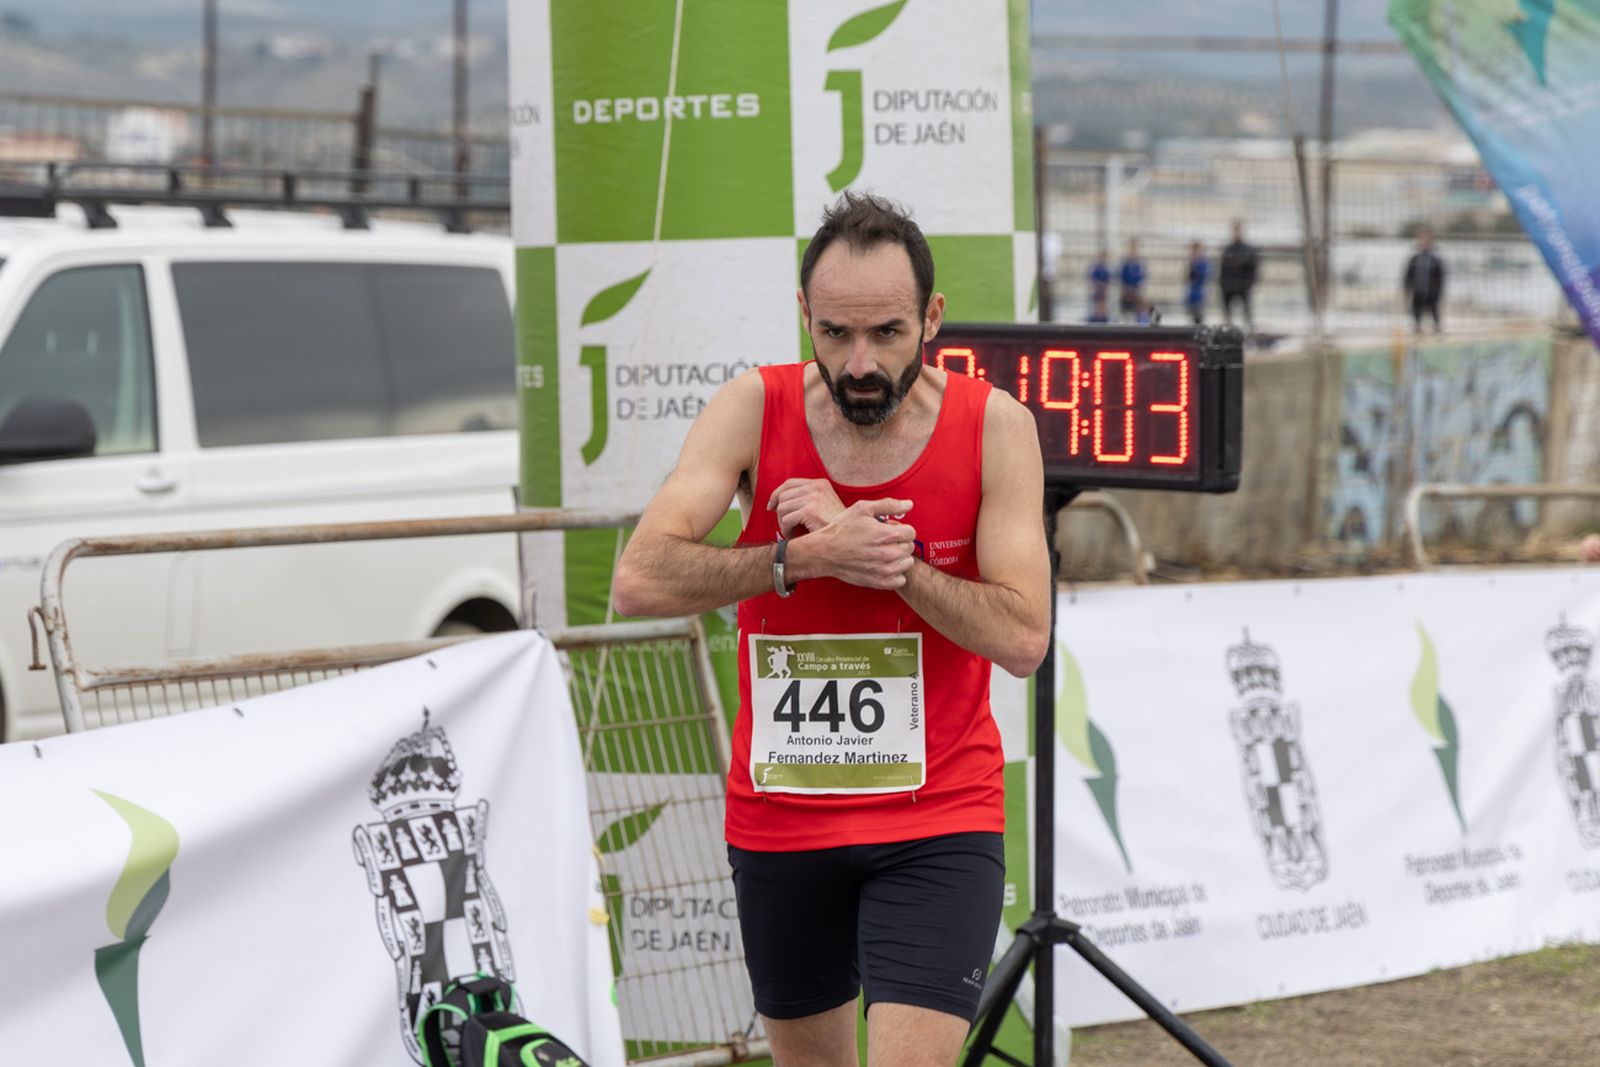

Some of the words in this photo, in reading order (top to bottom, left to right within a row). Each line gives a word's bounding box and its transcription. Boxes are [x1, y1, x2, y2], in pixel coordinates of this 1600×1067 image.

[573, 92, 760, 124] DEPORTES
[873, 85, 998, 112] DIPUTACIÓN
[874, 123, 907, 145] DE
[911, 119, 965, 145] JAÉN
[615, 358, 770, 388] DIPUTACIÓ
[616, 397, 649, 420] DE
[797, 663, 828, 672] Campo
[839, 661, 871, 670] través
[909, 671, 919, 680] A
[773, 679, 885, 734] 446
[909, 682, 919, 730] Veterano
[786, 735, 833, 745] Antonio
[836, 734, 874, 746] Javier
[768, 751, 840, 764] Fernandez
[844, 751, 908, 764] Martinez
[630, 896, 738, 919] DIPUTAC
